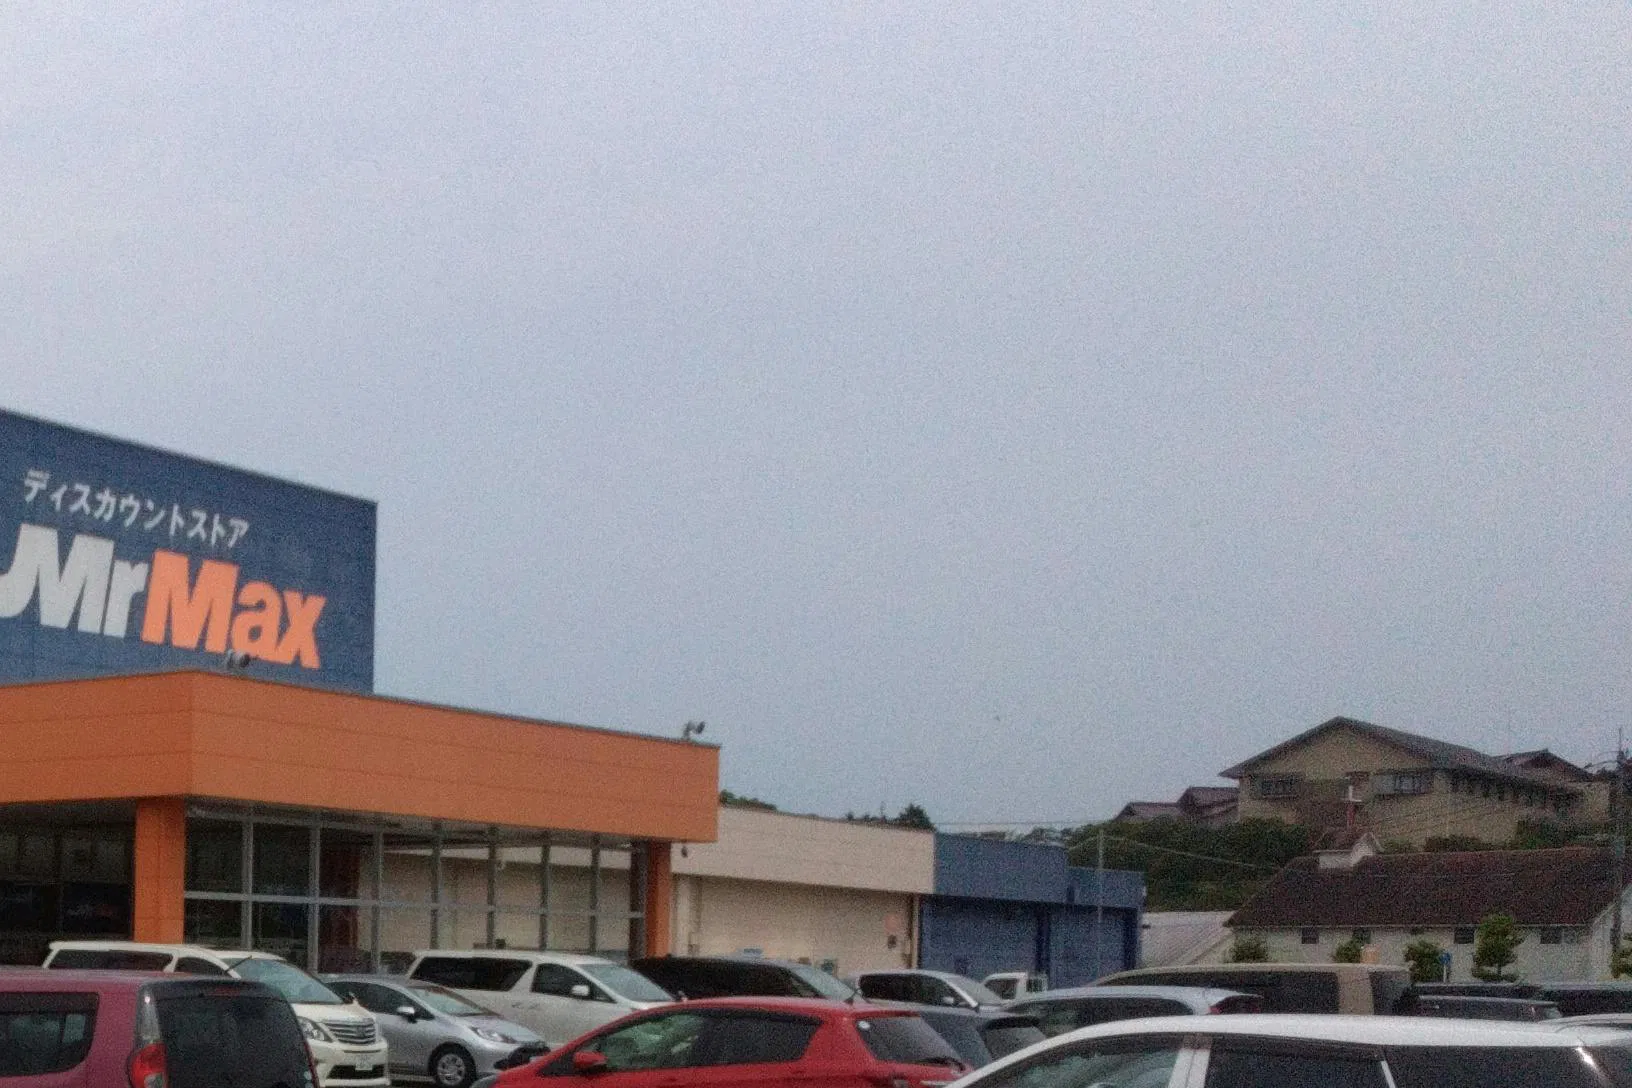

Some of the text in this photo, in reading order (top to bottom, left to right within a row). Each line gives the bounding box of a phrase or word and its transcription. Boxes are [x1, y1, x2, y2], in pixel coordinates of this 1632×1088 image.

[24, 468, 250, 549] ディスカウントストア
